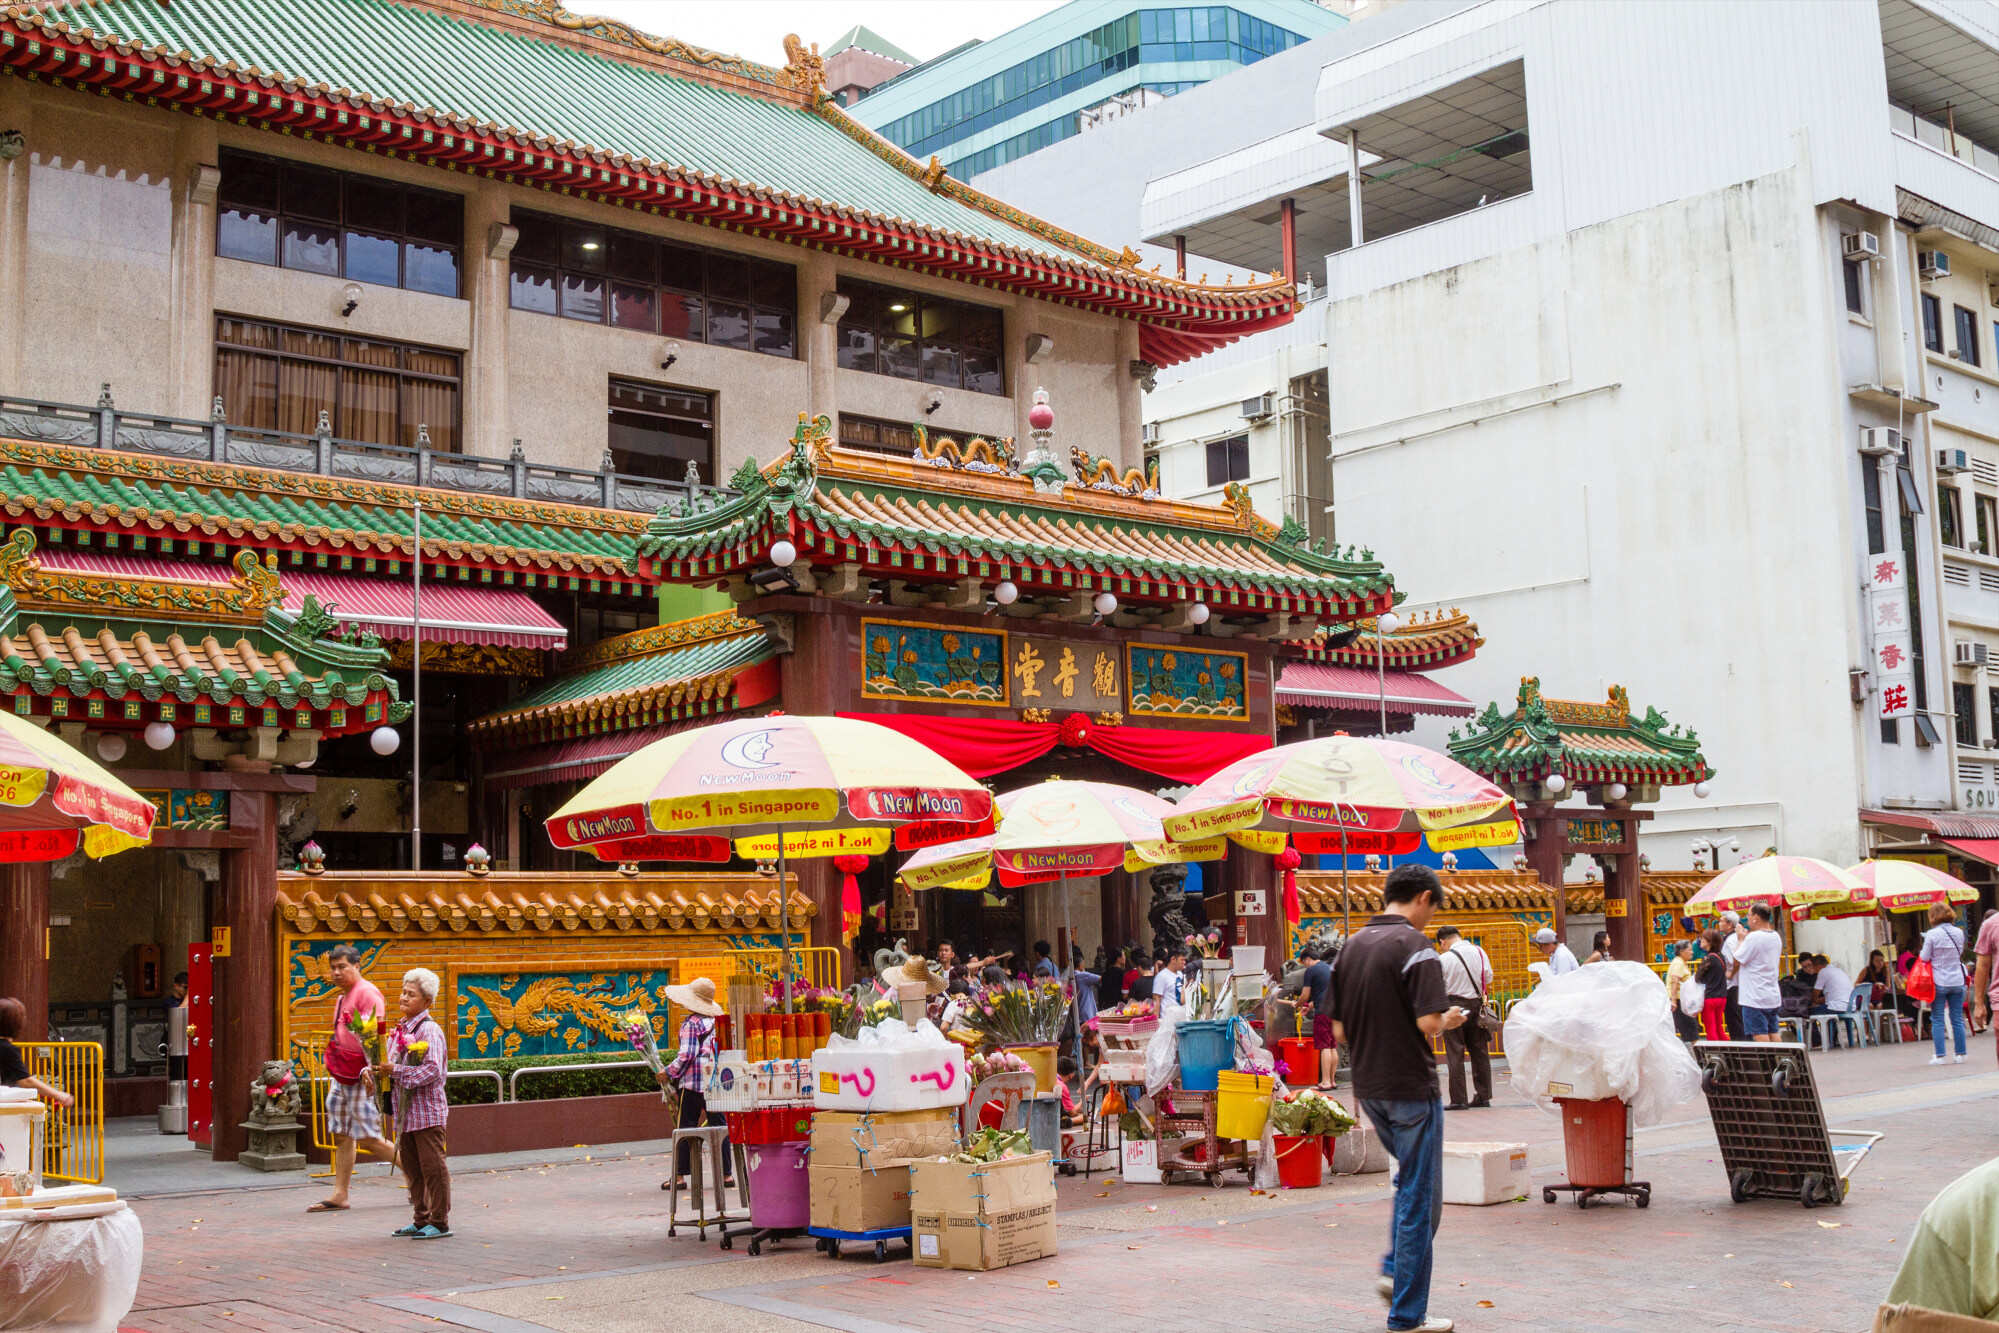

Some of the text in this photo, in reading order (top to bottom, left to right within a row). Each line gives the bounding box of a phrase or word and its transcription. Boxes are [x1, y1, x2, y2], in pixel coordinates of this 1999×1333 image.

[1966, 789, 1999, 808] SOU
[671, 800, 820, 821] No. 1 in Singapore
[1428, 808, 1445, 821] No.
[1174, 807, 1258, 833] No. 1 in Singapore
[1159, 843, 1167, 856] 1
[1168, 846, 1176, 855] in
[1178, 843, 1218, 855] Singapore
[916, 873, 933, 884] No.
[929, 866, 939, 879] 1
